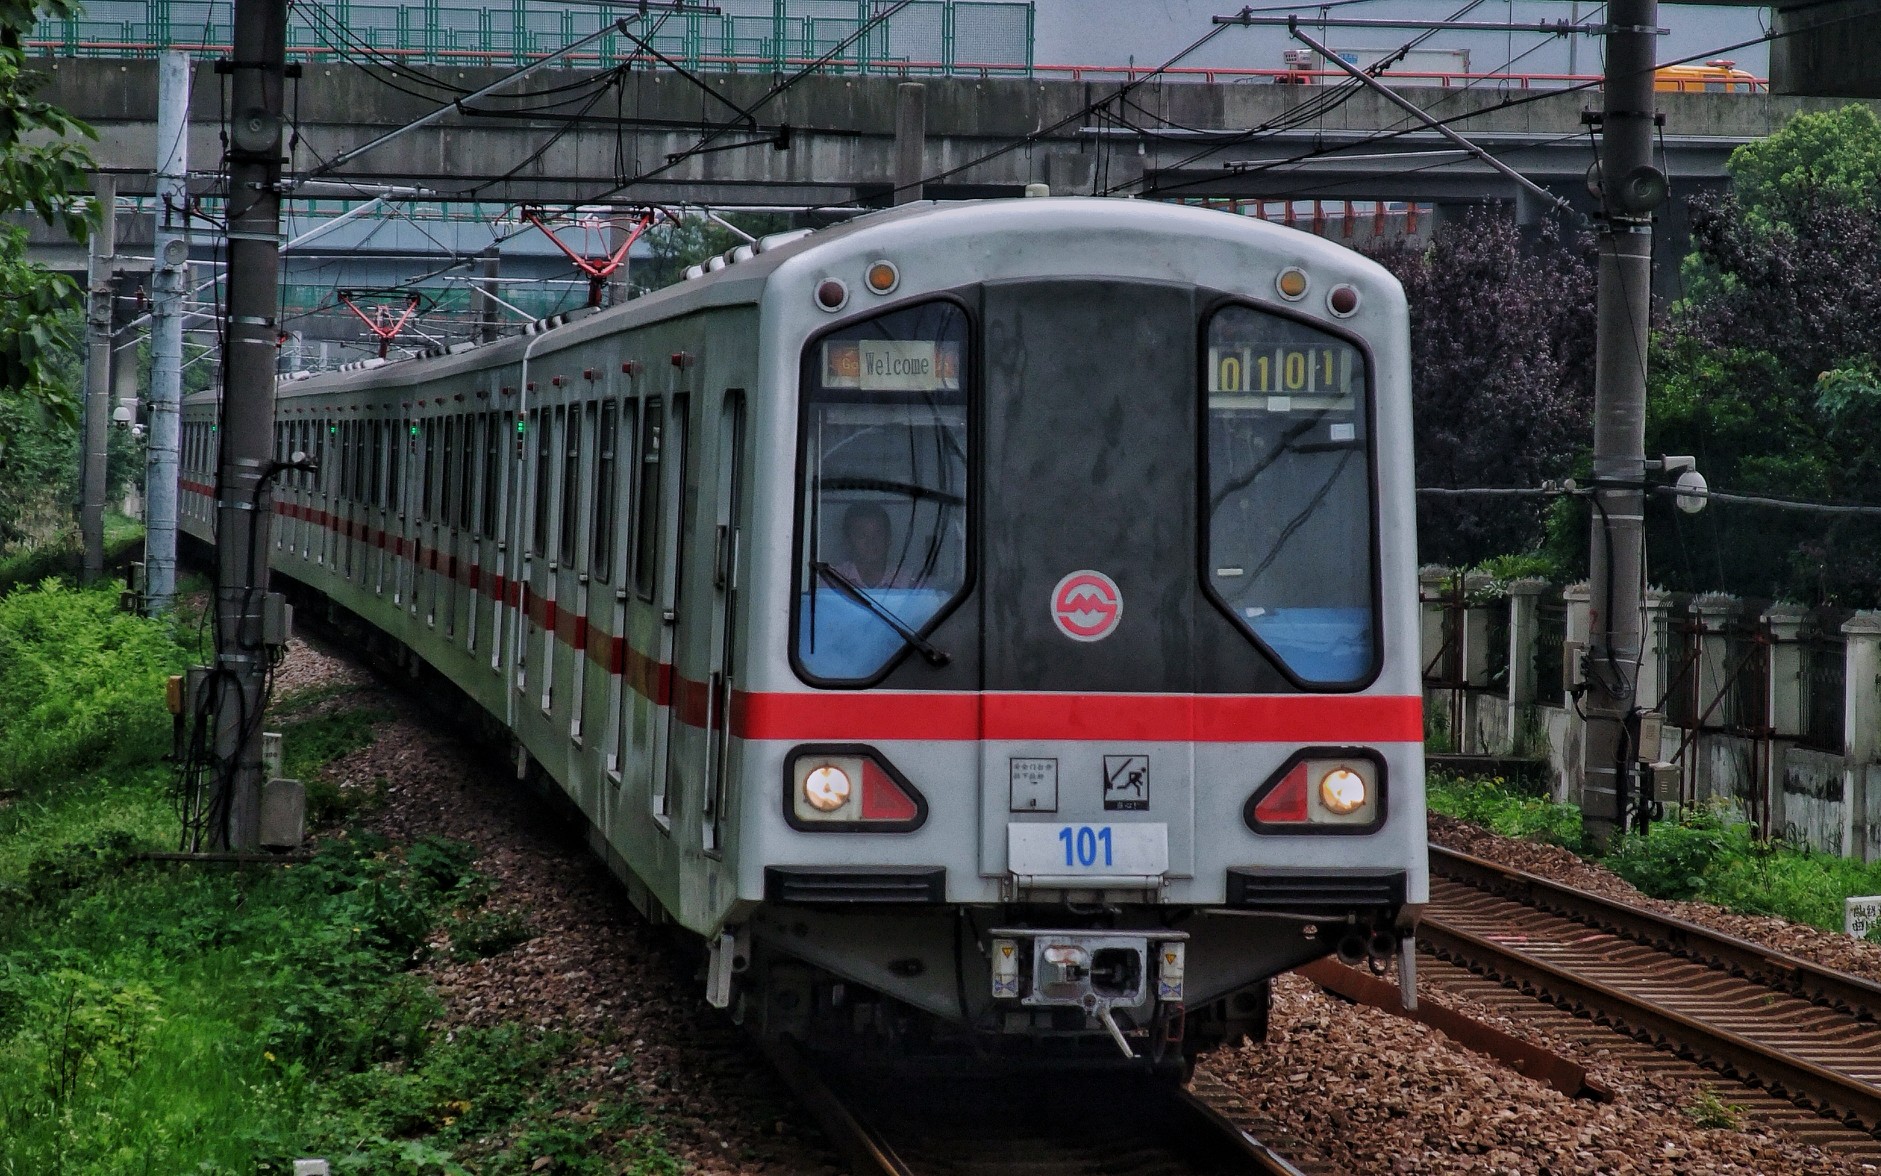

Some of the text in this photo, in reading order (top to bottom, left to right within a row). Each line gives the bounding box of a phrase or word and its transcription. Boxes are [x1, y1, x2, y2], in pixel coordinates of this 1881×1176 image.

[865, 351, 930, 376] Welcome
[1221, 351, 1333, 392] 0101
[1059, 826, 1113, 866] 101
